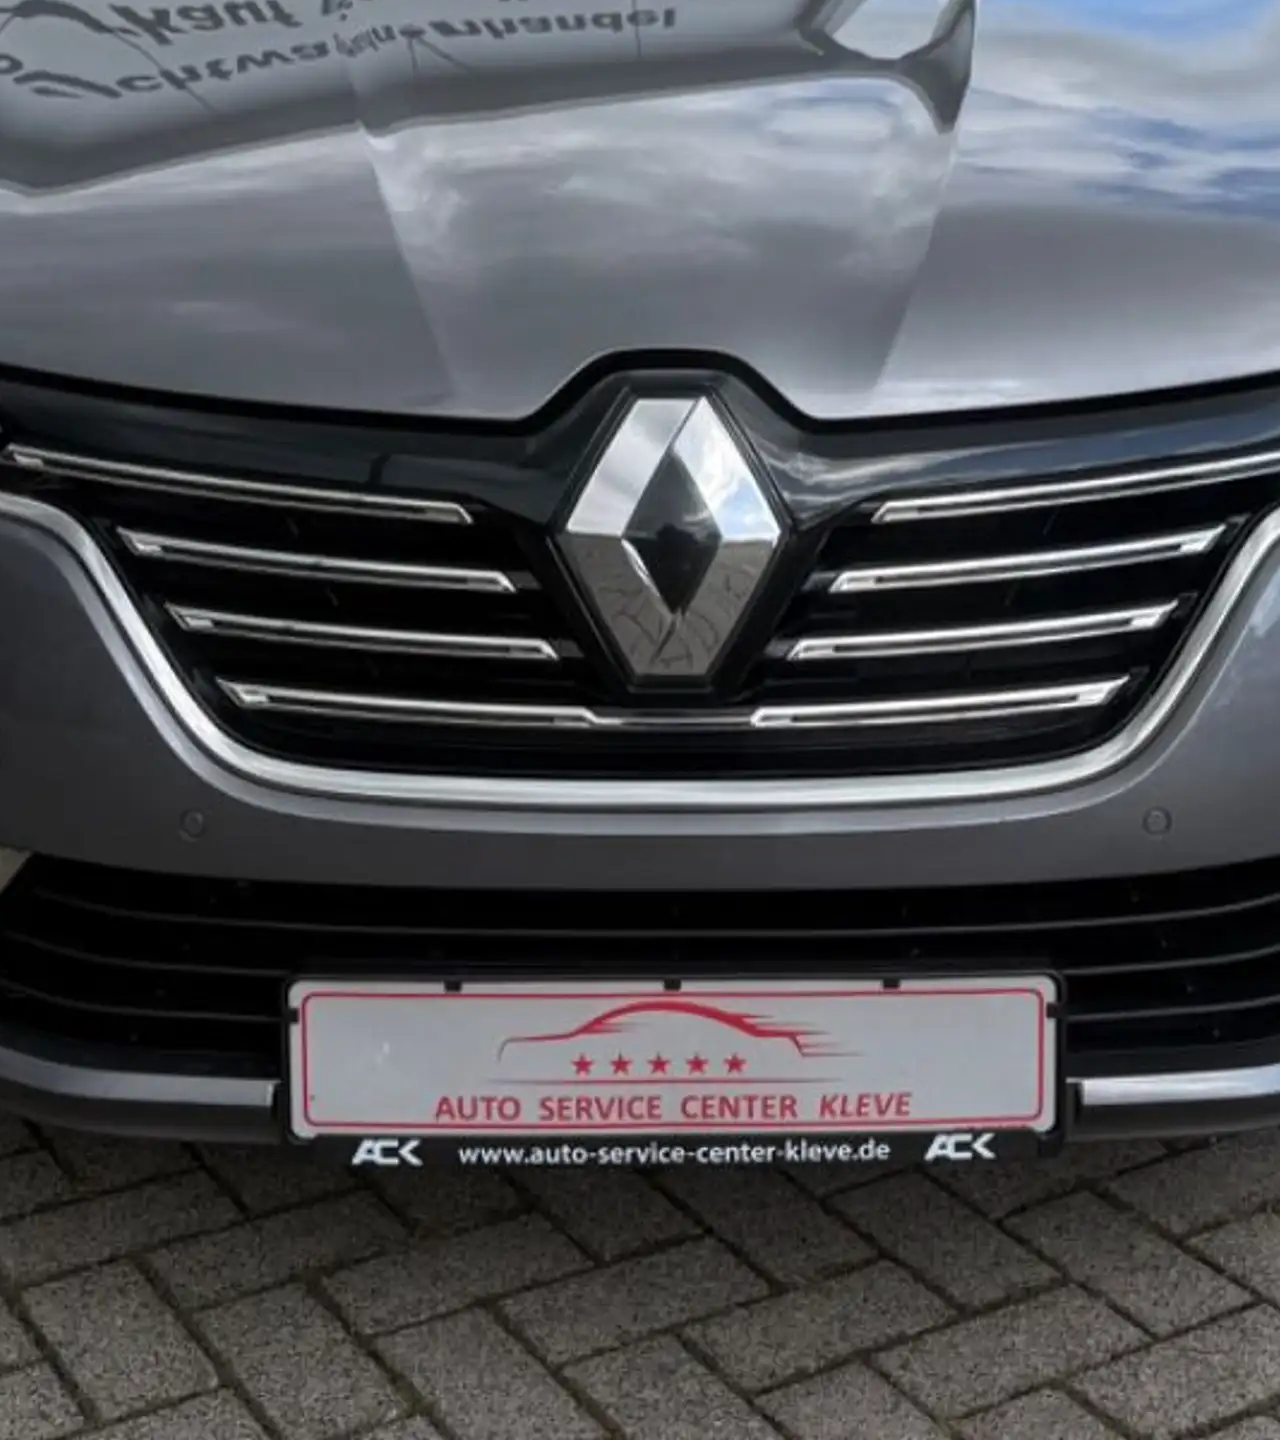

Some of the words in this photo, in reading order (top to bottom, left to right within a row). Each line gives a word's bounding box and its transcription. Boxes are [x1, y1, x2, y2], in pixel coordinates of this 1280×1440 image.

[434, 1095, 522, 1123] AUTO
[538, 1094, 664, 1122] SERVICE
[679, 1093, 799, 1121] CENTER
[818, 1091, 913, 1119] KLEVE
[457, 1136, 892, 1167] www.auto-service-center-kleve.de
